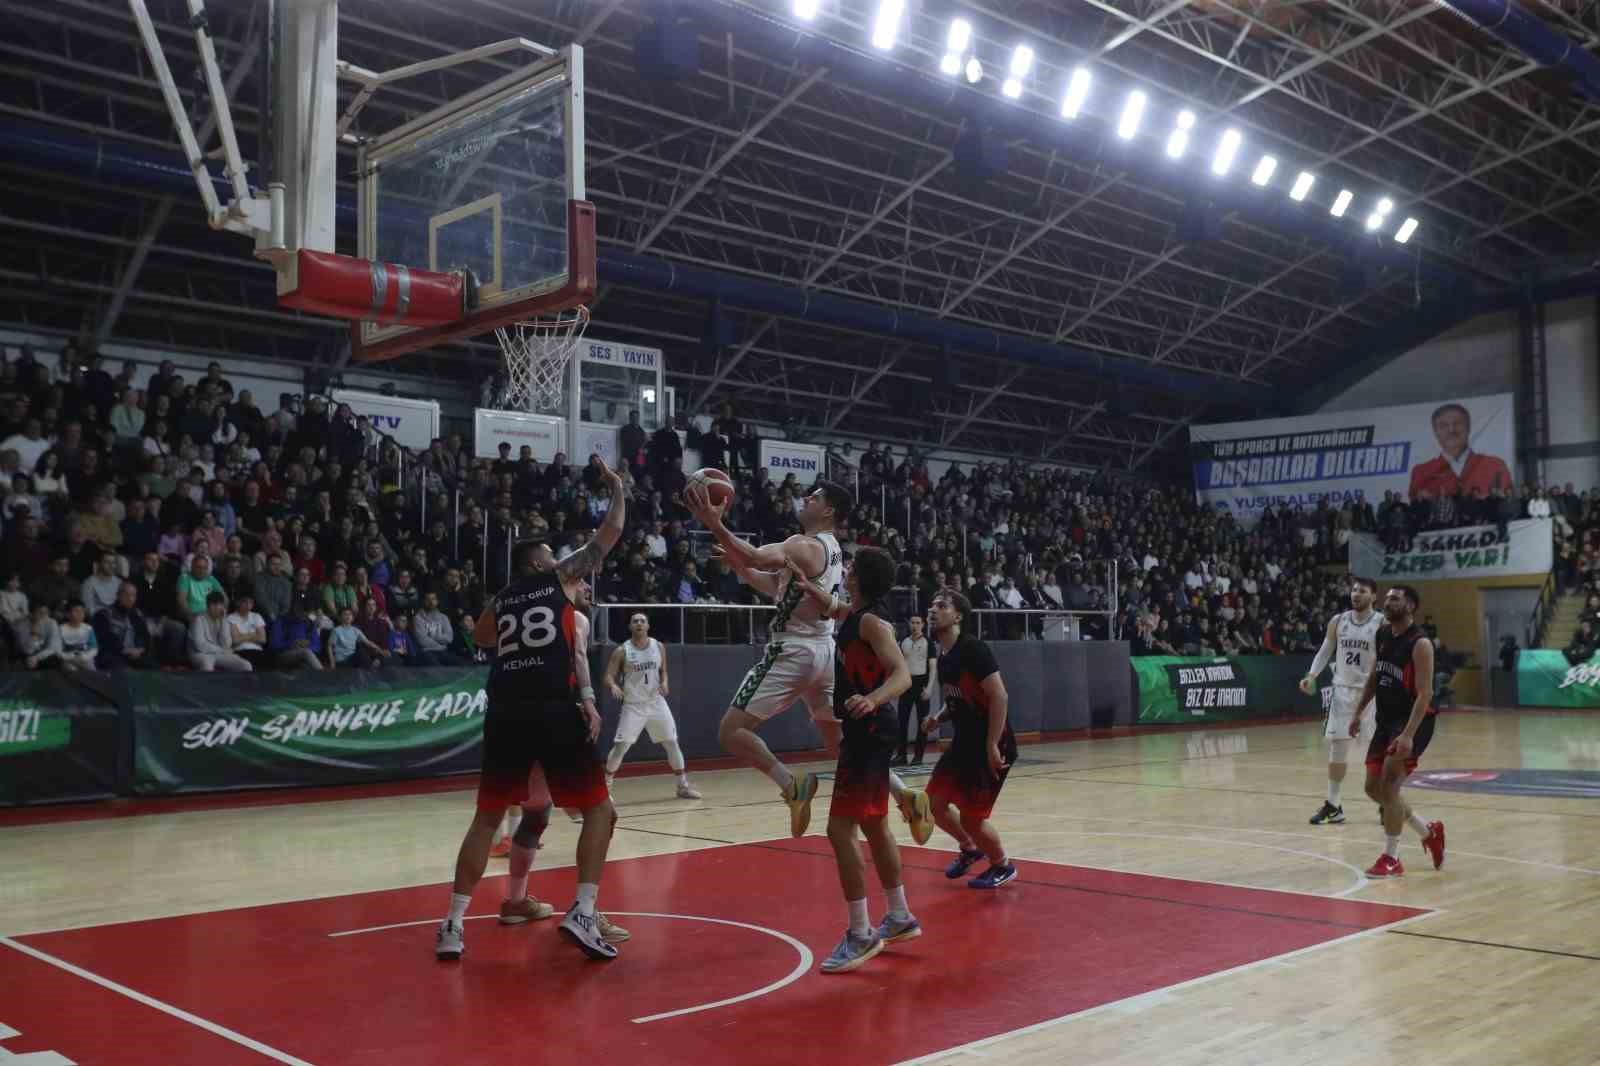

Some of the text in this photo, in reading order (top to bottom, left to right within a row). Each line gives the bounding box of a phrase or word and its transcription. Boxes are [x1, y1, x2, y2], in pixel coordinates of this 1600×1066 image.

[590, 344, 656, 367] SES YAYIN
[770, 456, 816, 471] BASIN
[497, 605, 557, 656] 28
[503, 656, 544, 671] KEMAL
[1346, 652, 1361, 665] 24
[644, 672, 649, 684] 1
[181, 717, 249, 750] SON
[413, 688, 488, 723] KADA
